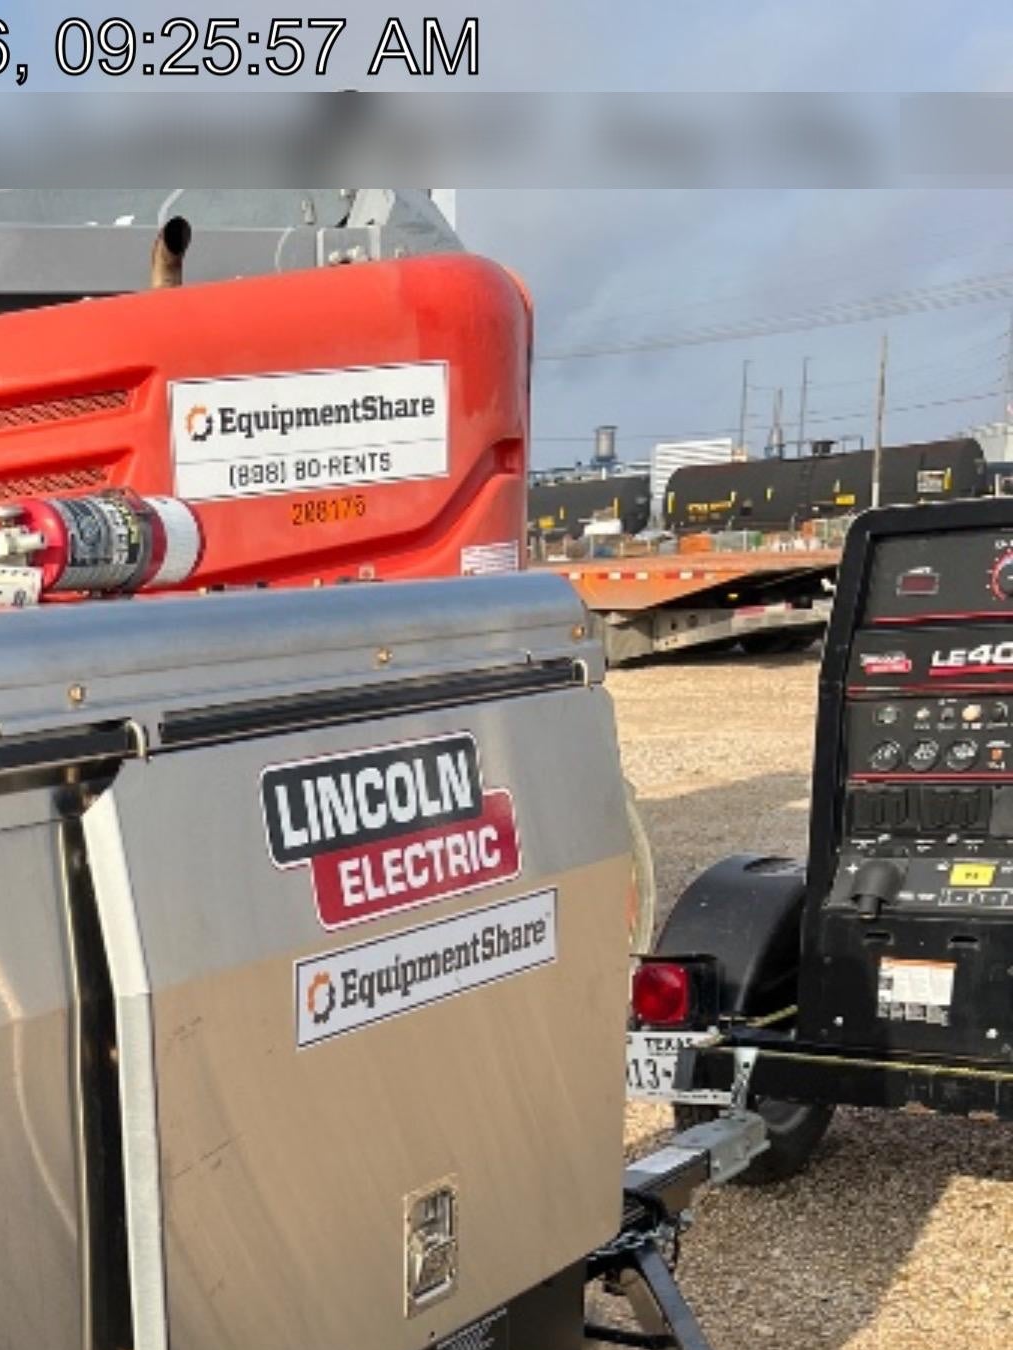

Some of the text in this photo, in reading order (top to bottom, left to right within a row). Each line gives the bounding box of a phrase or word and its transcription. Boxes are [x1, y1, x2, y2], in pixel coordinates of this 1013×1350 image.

[218, 395, 435, 438] EquipmentShare
[295, 452, 392, 481] 80-RENTS
[275, 749, 475, 849] LINCOLN
[338, 824, 502, 907] ELECTRIC
[341, 917, 546, 1008] EquipmentShare
